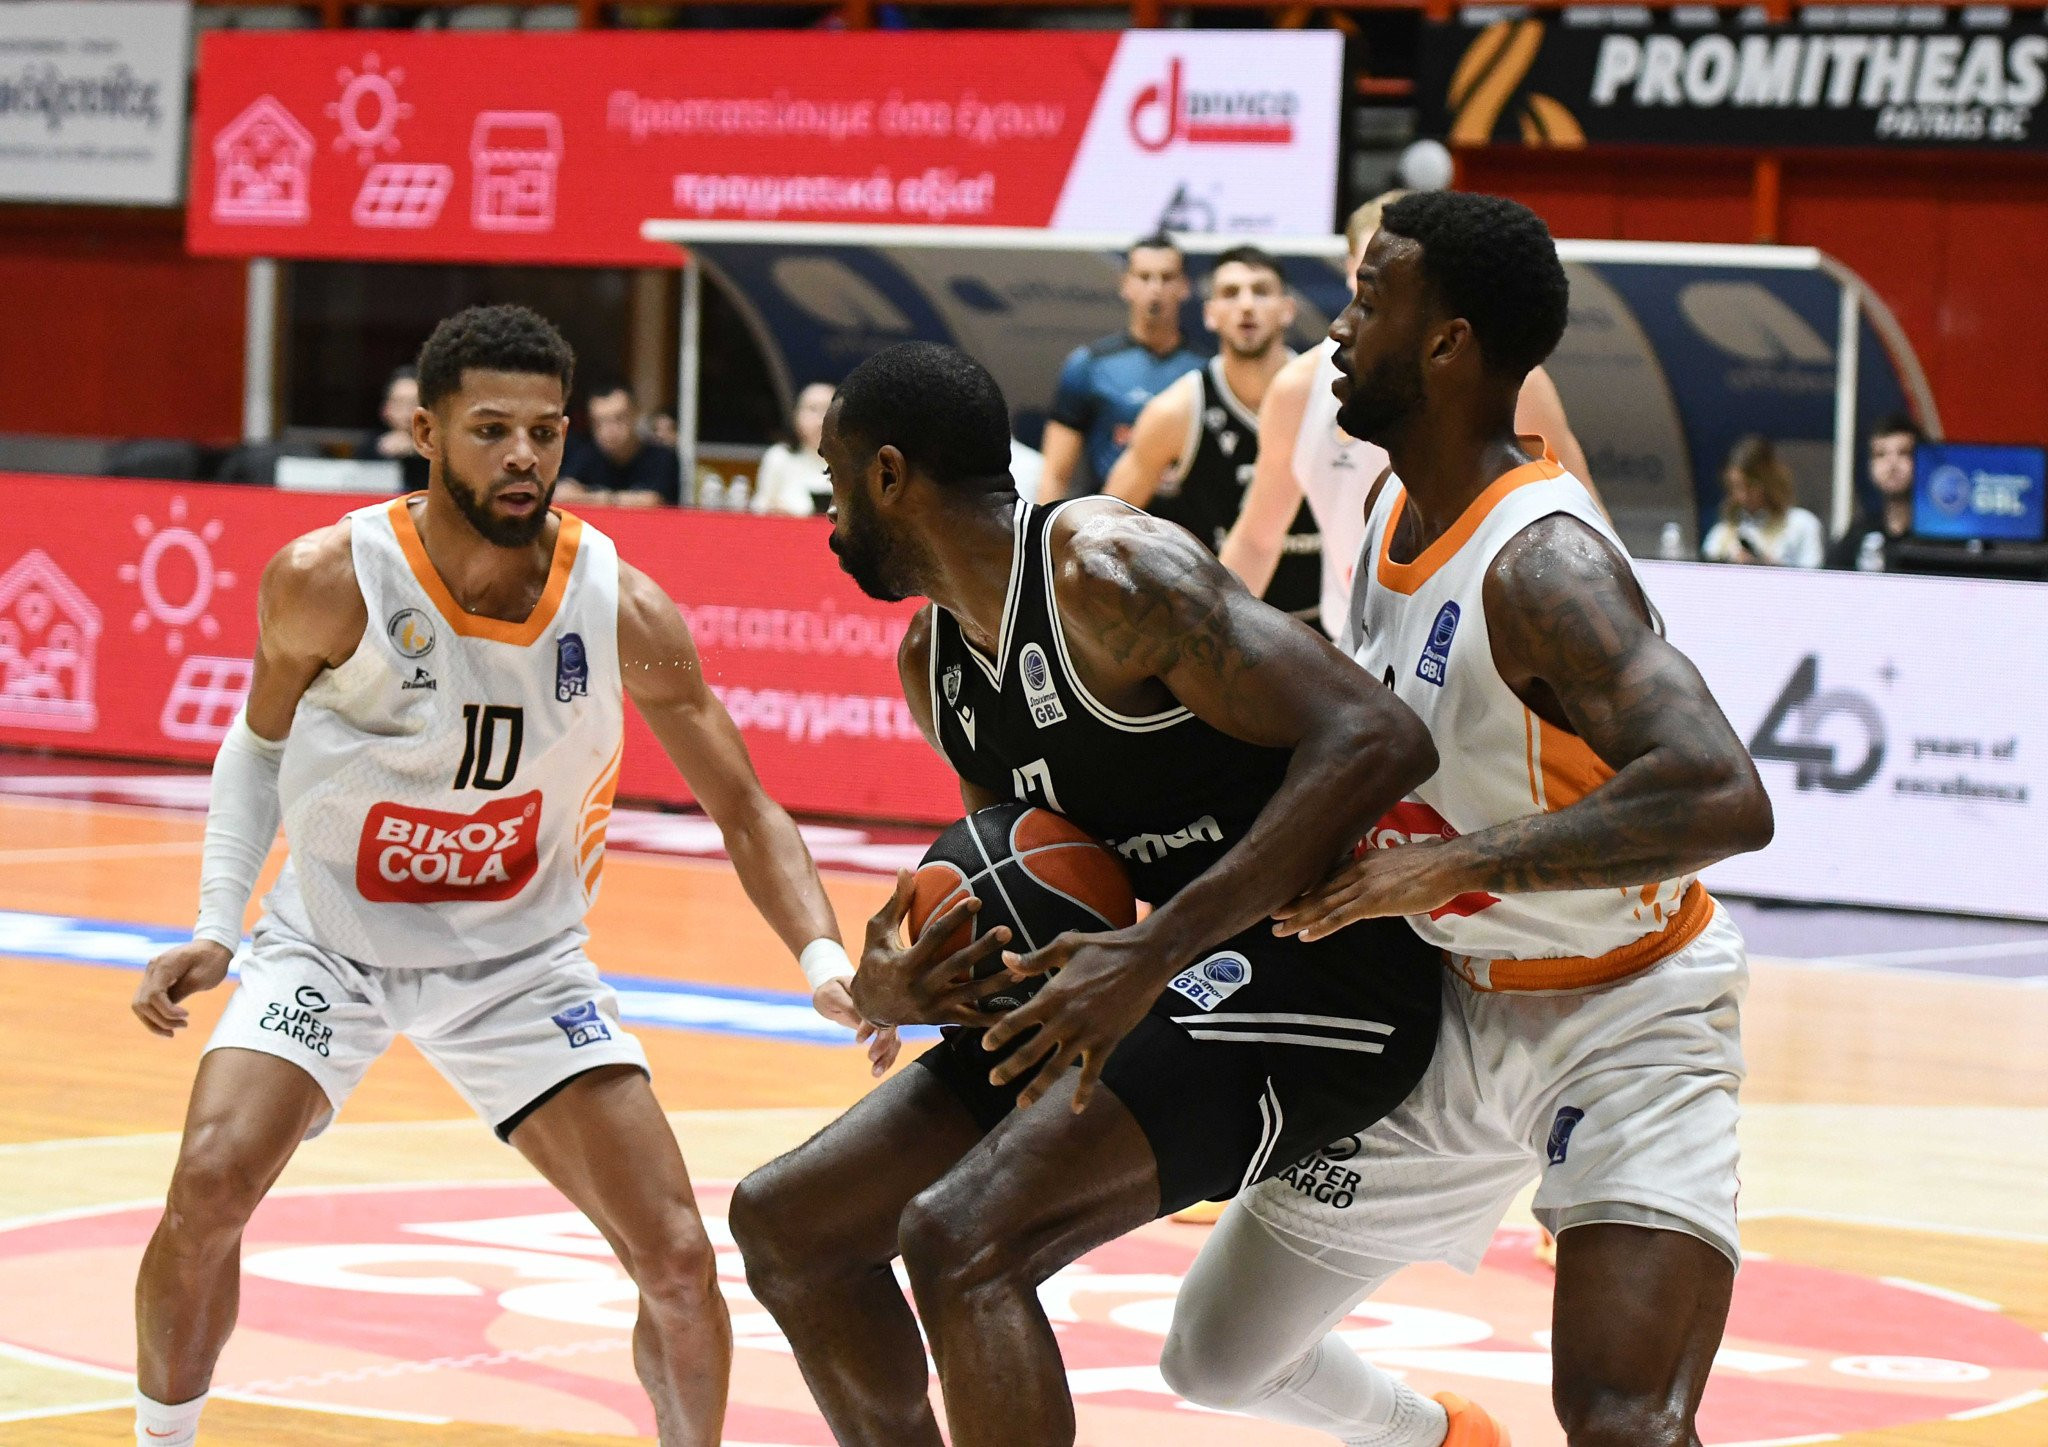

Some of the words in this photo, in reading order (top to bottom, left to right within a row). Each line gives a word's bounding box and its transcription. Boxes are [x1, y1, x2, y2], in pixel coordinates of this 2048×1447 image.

[1590, 34, 2047, 108] PROMITHEAS
[1420, 659, 1442, 682] GBL
[1030, 692, 1058, 707] Stoiximan
[1035, 704, 1064, 724] GBL
[453, 704, 524, 790] 10
[378, 845, 511, 886] COLA
[1173, 977, 1211, 1008] GBL
[259, 1016, 330, 1058] CARGO
[265, 1002, 333, 1045] SUPER
[1278, 1166, 1354, 1210] ARGO
[1296, 1154, 1362, 1193] UPER
